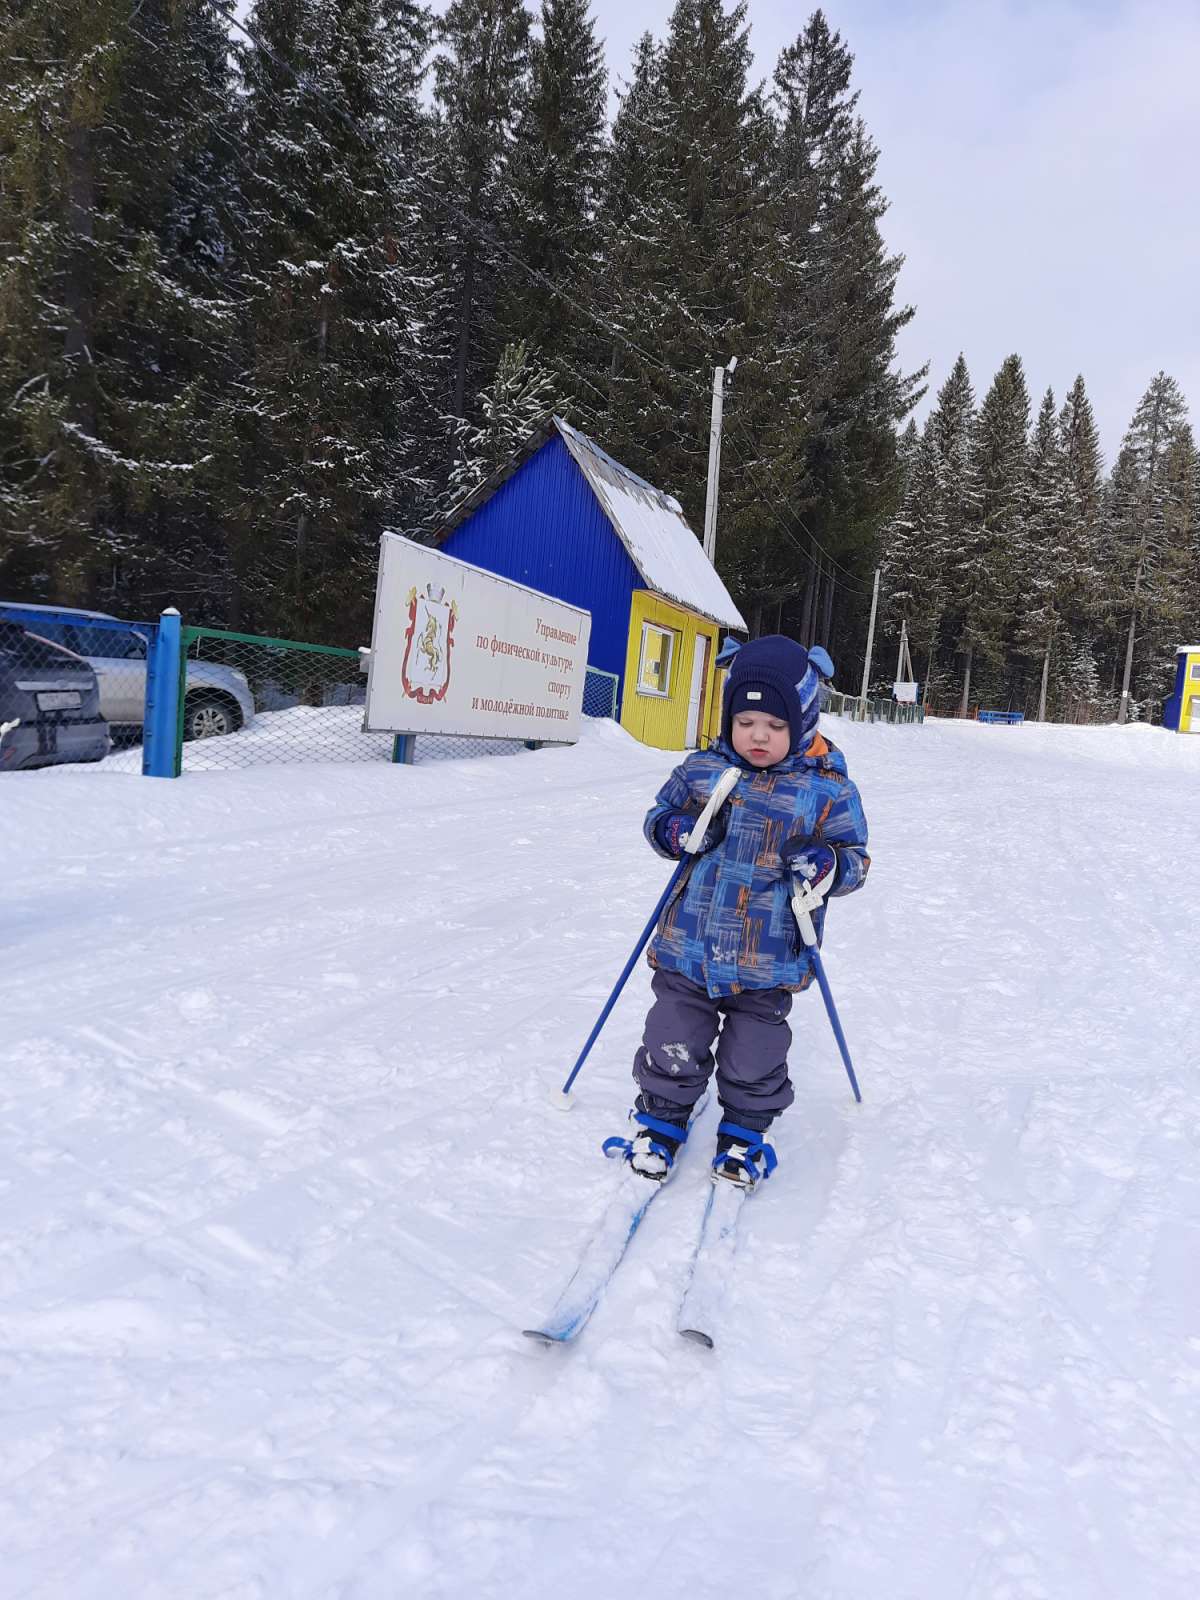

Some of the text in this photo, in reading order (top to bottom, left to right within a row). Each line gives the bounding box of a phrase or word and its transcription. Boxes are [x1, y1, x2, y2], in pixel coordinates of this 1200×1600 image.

[536, 618, 577, 645] Управление
[476, 634, 489, 650] по
[490, 635, 541, 662] физической
[547, 680, 572, 700] спорту
[472, 697, 569, 721] и молодёжной политике
